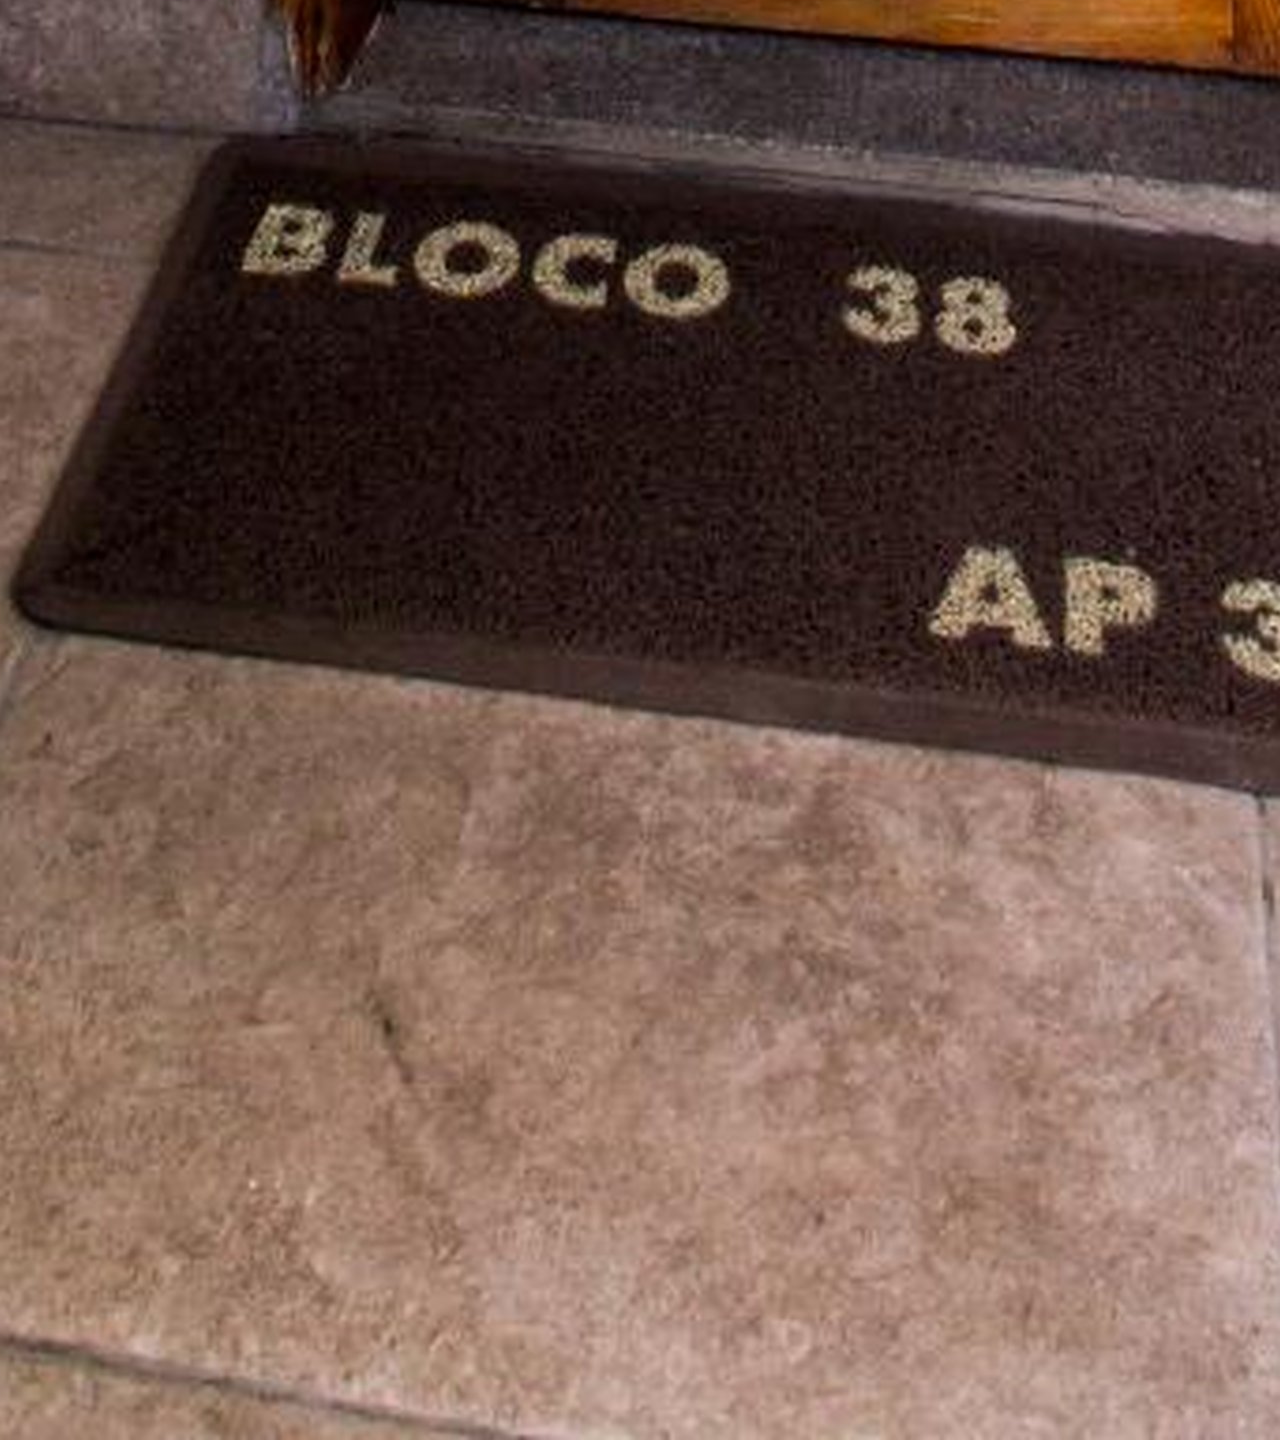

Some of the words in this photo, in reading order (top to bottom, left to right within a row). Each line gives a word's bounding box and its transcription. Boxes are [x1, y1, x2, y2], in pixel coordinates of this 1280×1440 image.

[241, 204, 730, 318] BLOCO
[843, 264, 1017, 355] 38
[928, 546, 1158, 655] AP
